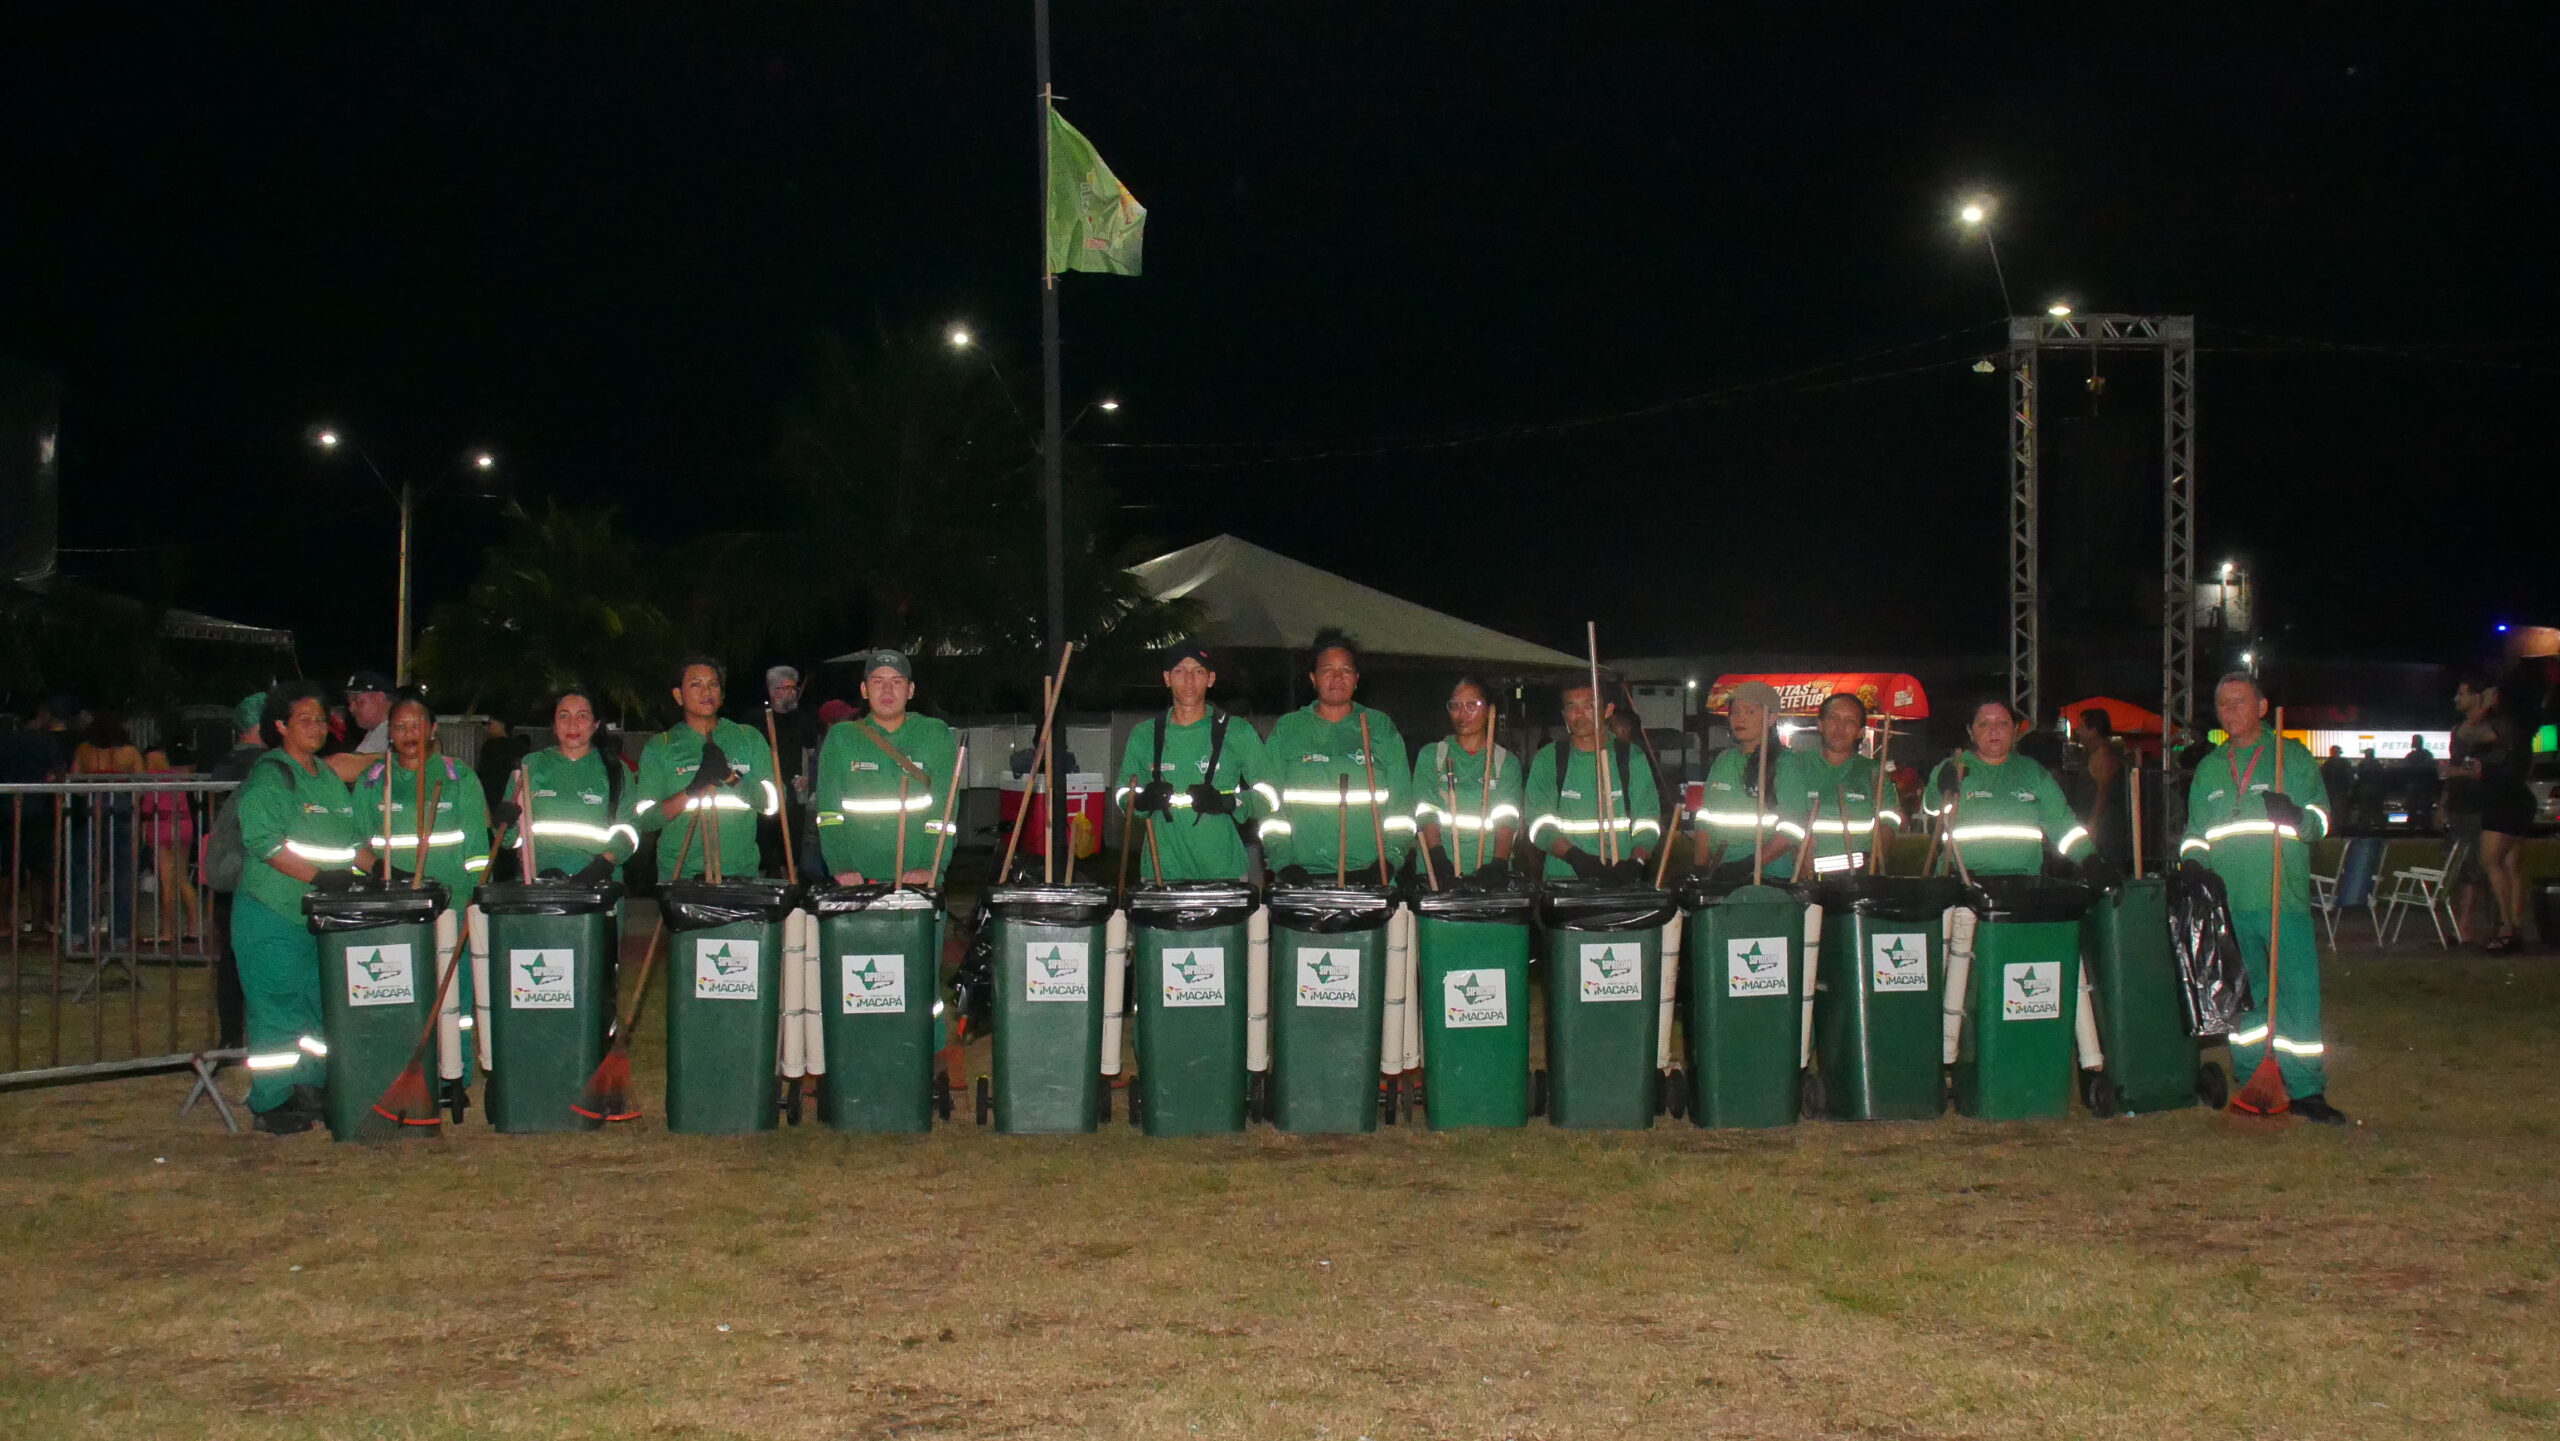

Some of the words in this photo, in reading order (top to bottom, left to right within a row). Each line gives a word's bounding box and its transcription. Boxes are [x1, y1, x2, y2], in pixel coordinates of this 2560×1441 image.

[2382, 741, 2447, 750] PETRRAS
[1744, 976, 1785, 989] MACAPÁ
[1888, 973, 1926, 984] MACAPÁ
[366, 985, 411, 998] MACAPÁ
[712, 980, 755, 992] MACAPÁ
[1042, 983, 1085, 994] MACAPÁ
[1597, 982, 1639, 994] MACAPÁ
[527, 990, 571, 1001] MACAPÁ
[1179, 988, 1222, 999] MACAPÁ
[1313, 988, 1356, 1000] MACAPÁ
[859, 995, 902, 1006] MACAPÁ
[2018, 1001, 2057, 1013] MACAPÁ
[1461, 1008, 1505, 1021] MACAPÁ
